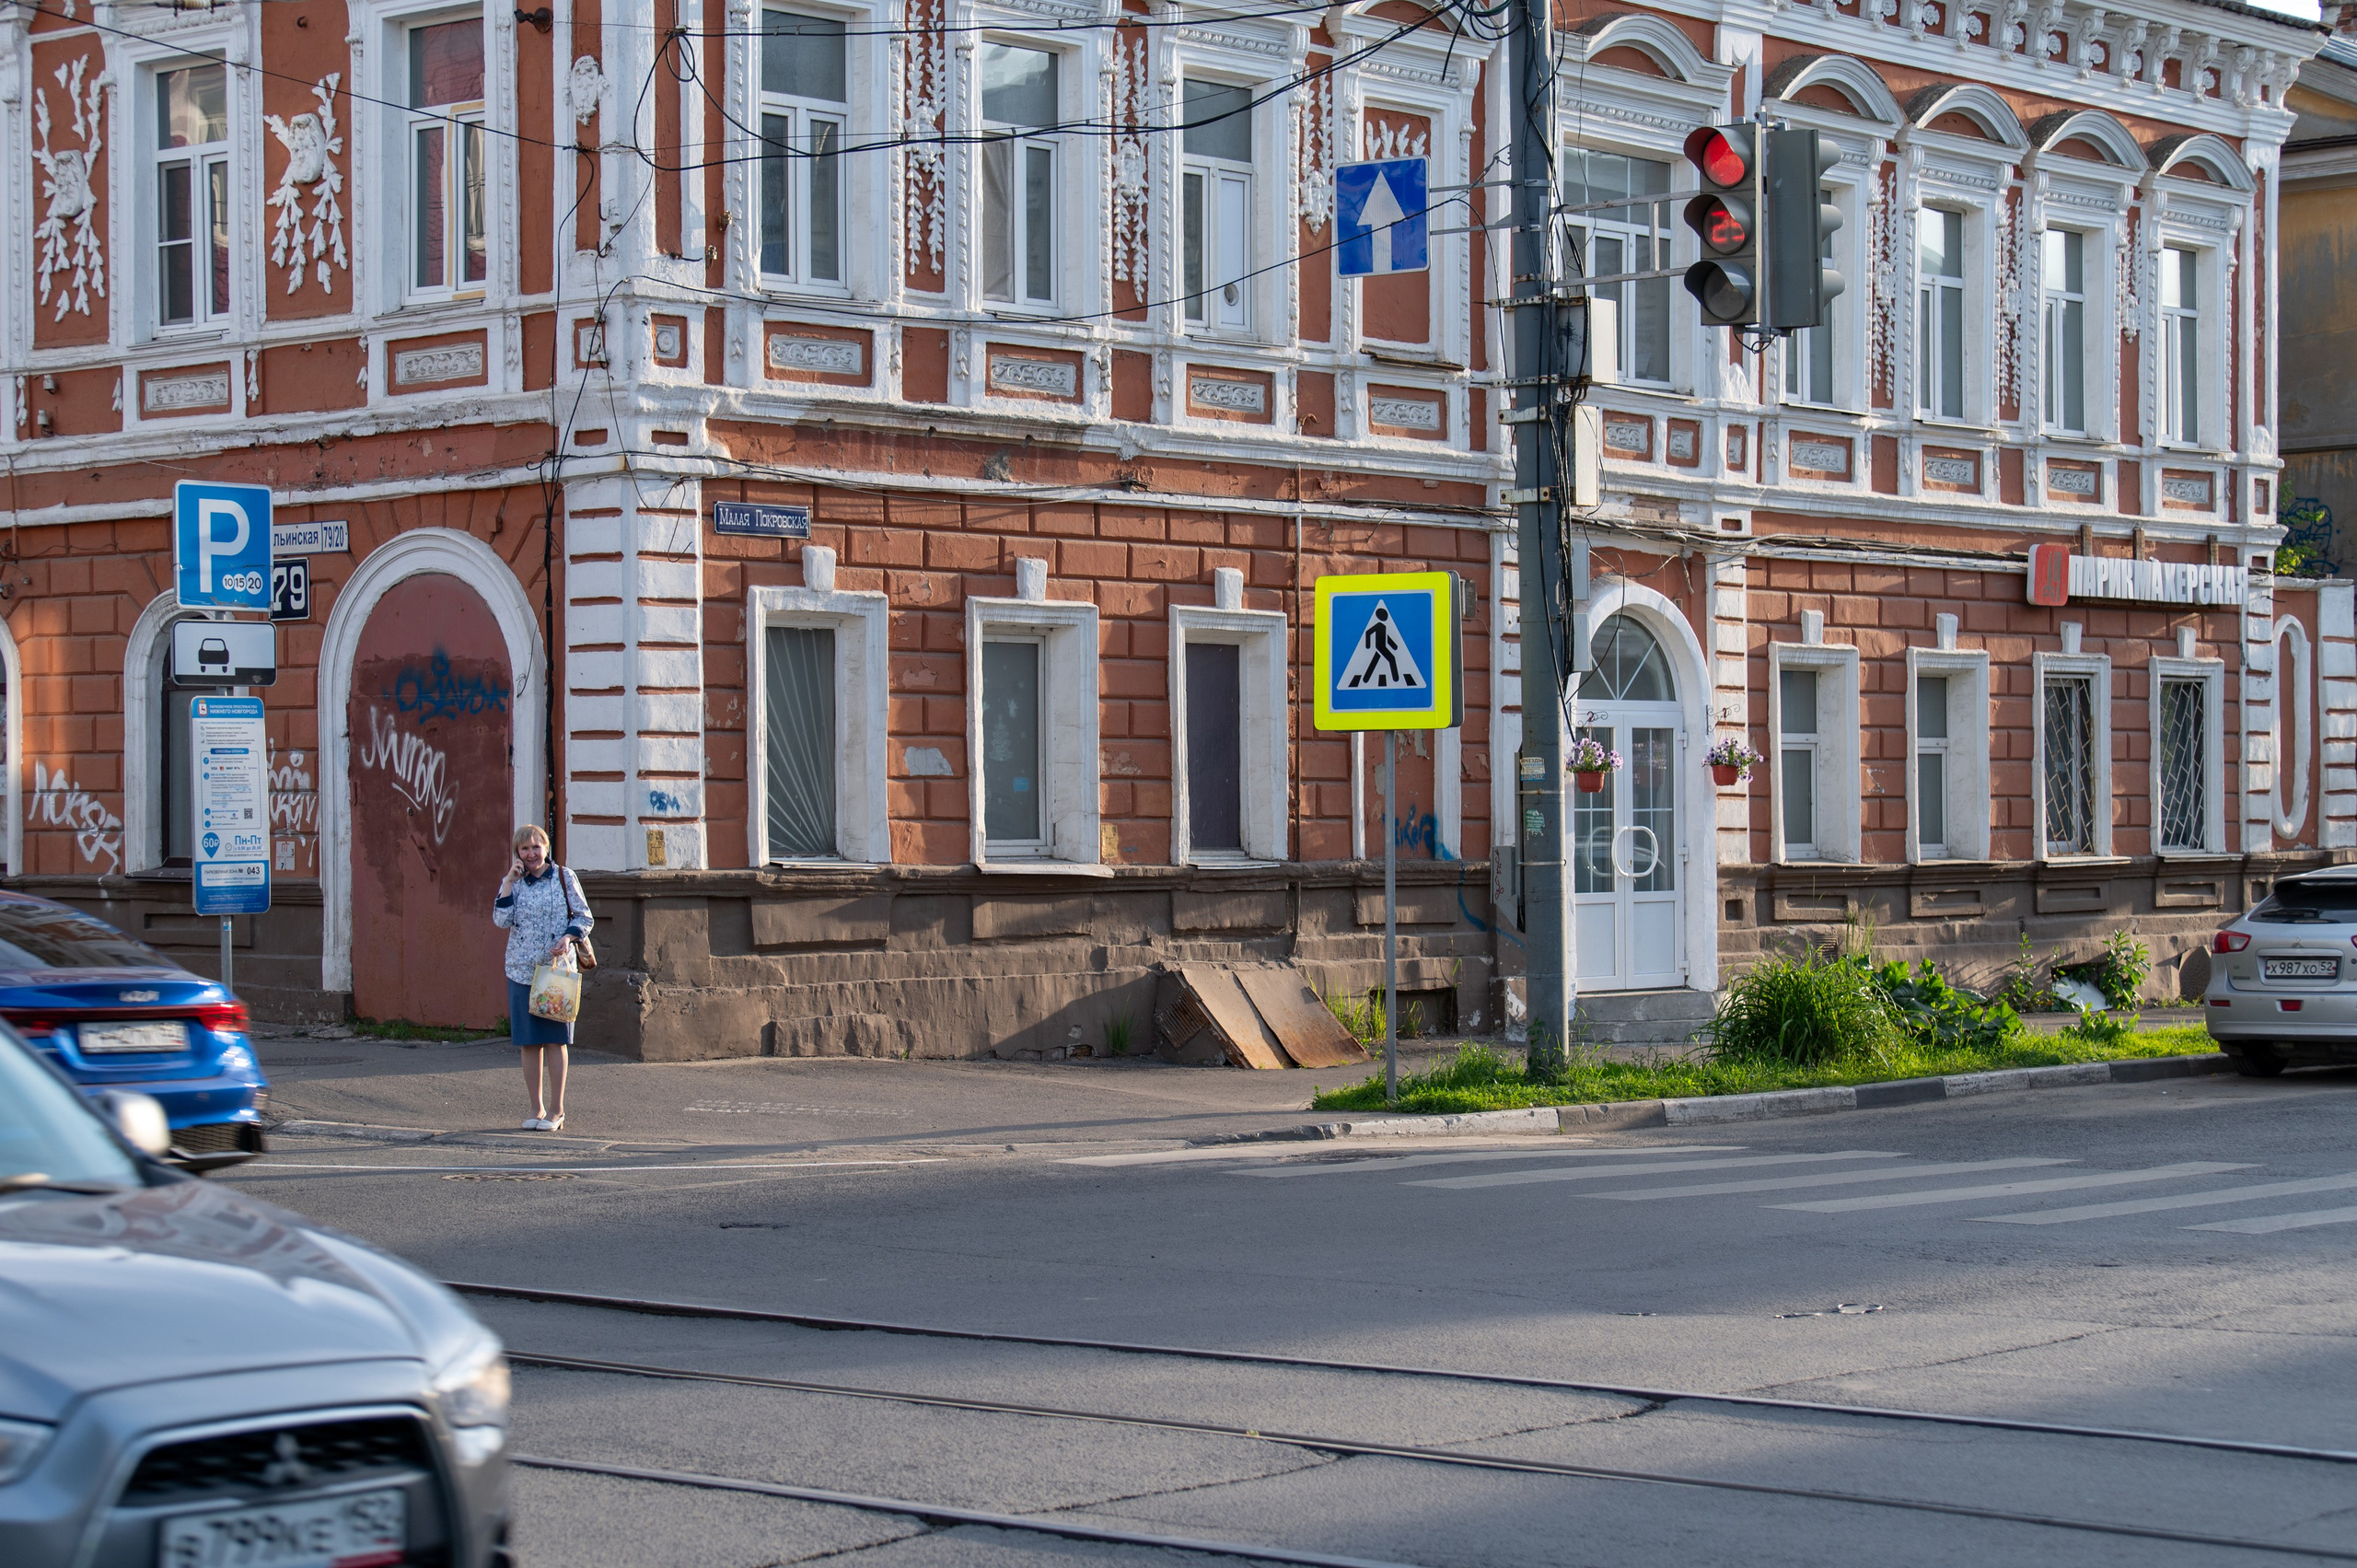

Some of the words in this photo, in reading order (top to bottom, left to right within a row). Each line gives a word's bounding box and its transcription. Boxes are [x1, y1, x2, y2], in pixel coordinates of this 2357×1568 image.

[198, 498, 250, 593] P
[273, 530, 319, 547] льинская
[323, 525, 344, 549] 79/20
[224, 577, 233, 587] 10
[235, 576, 246, 588] 15
[248, 577, 262, 590] 20
[273, 565, 306, 611] 79
[2069, 554, 2248, 605] ПАРИКМАХЕРСКАЯ
[235, 834, 262, 845] Пн-Пт
[247, 866, 261, 875] 043
[2320, 961, 2333, 971] 52
